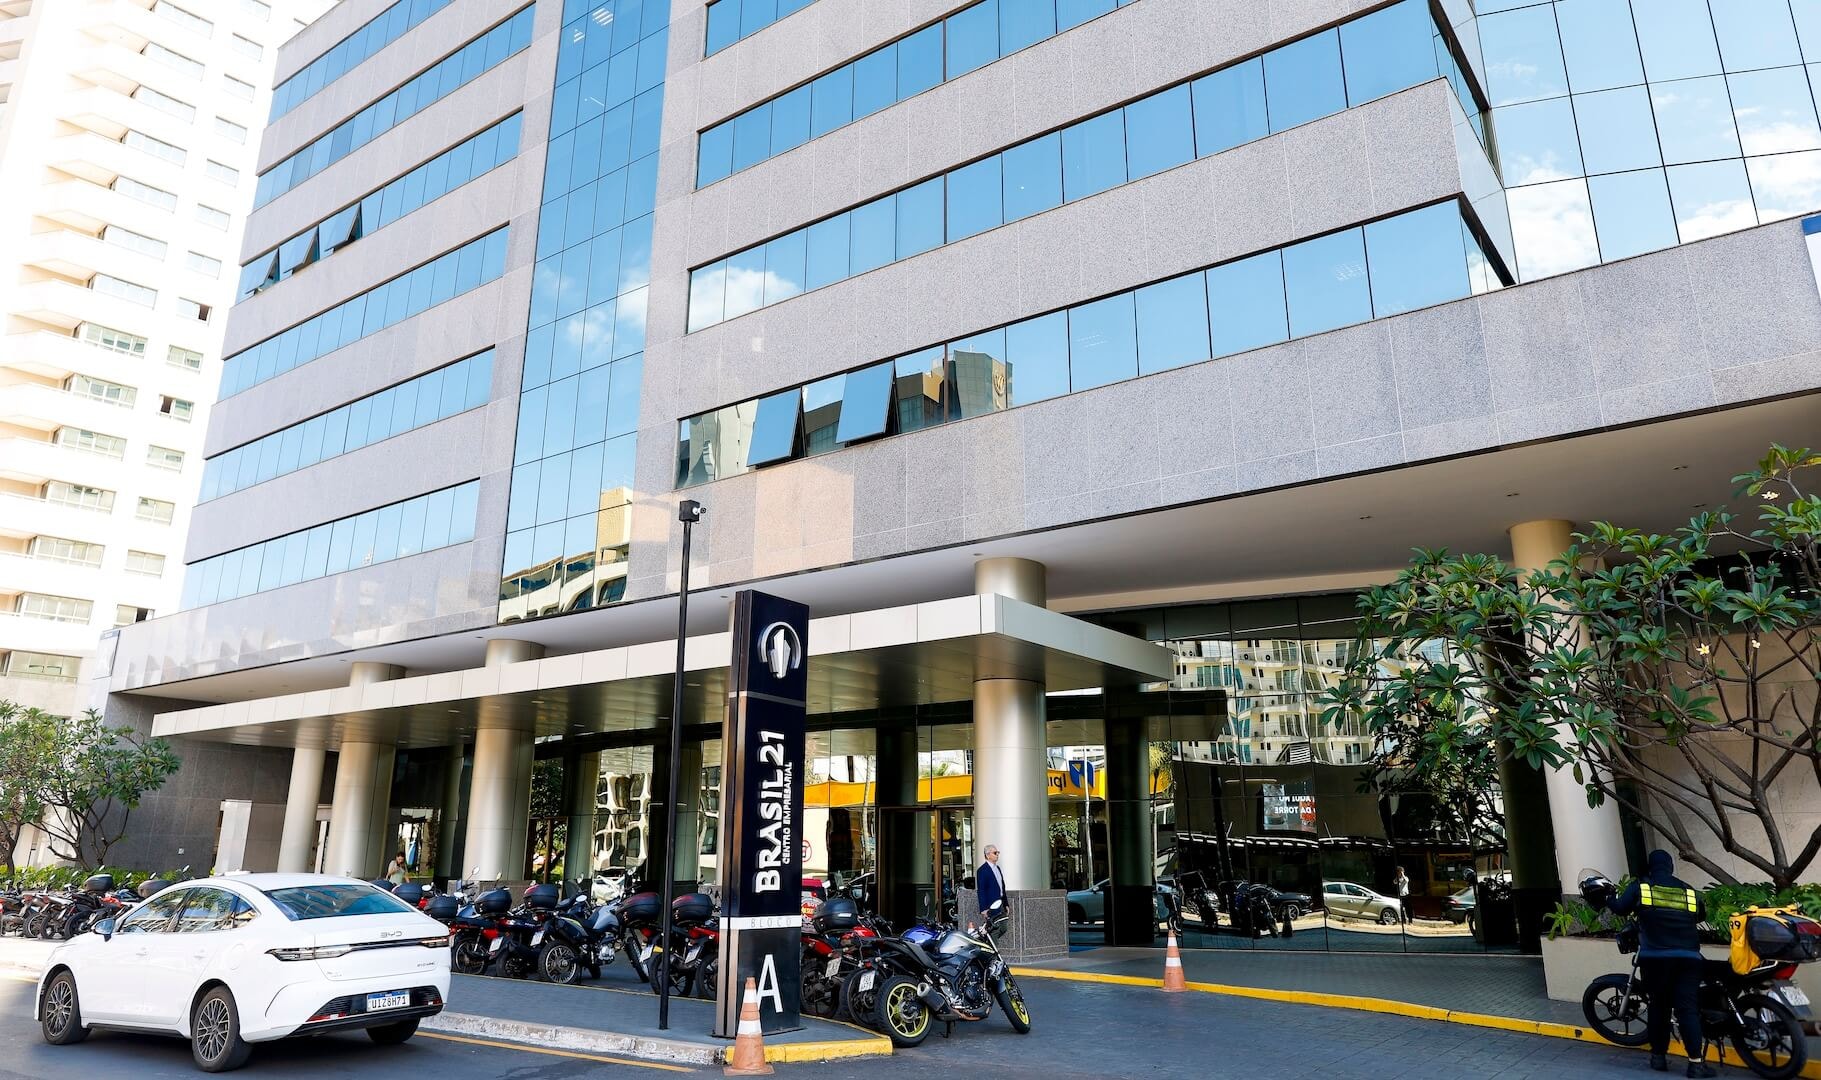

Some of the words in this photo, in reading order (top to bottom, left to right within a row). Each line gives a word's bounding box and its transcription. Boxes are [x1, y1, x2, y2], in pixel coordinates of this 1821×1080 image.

[759, 731, 785, 766] 21
[783, 761, 793, 825] EMPRESARIAL
[754, 769, 784, 893] BRASIL
[782, 827, 791, 865] CENTRO
[380, 931, 402, 939] BYD
[751, 917, 792, 928] BLOCO
[756, 953, 784, 1013] A
